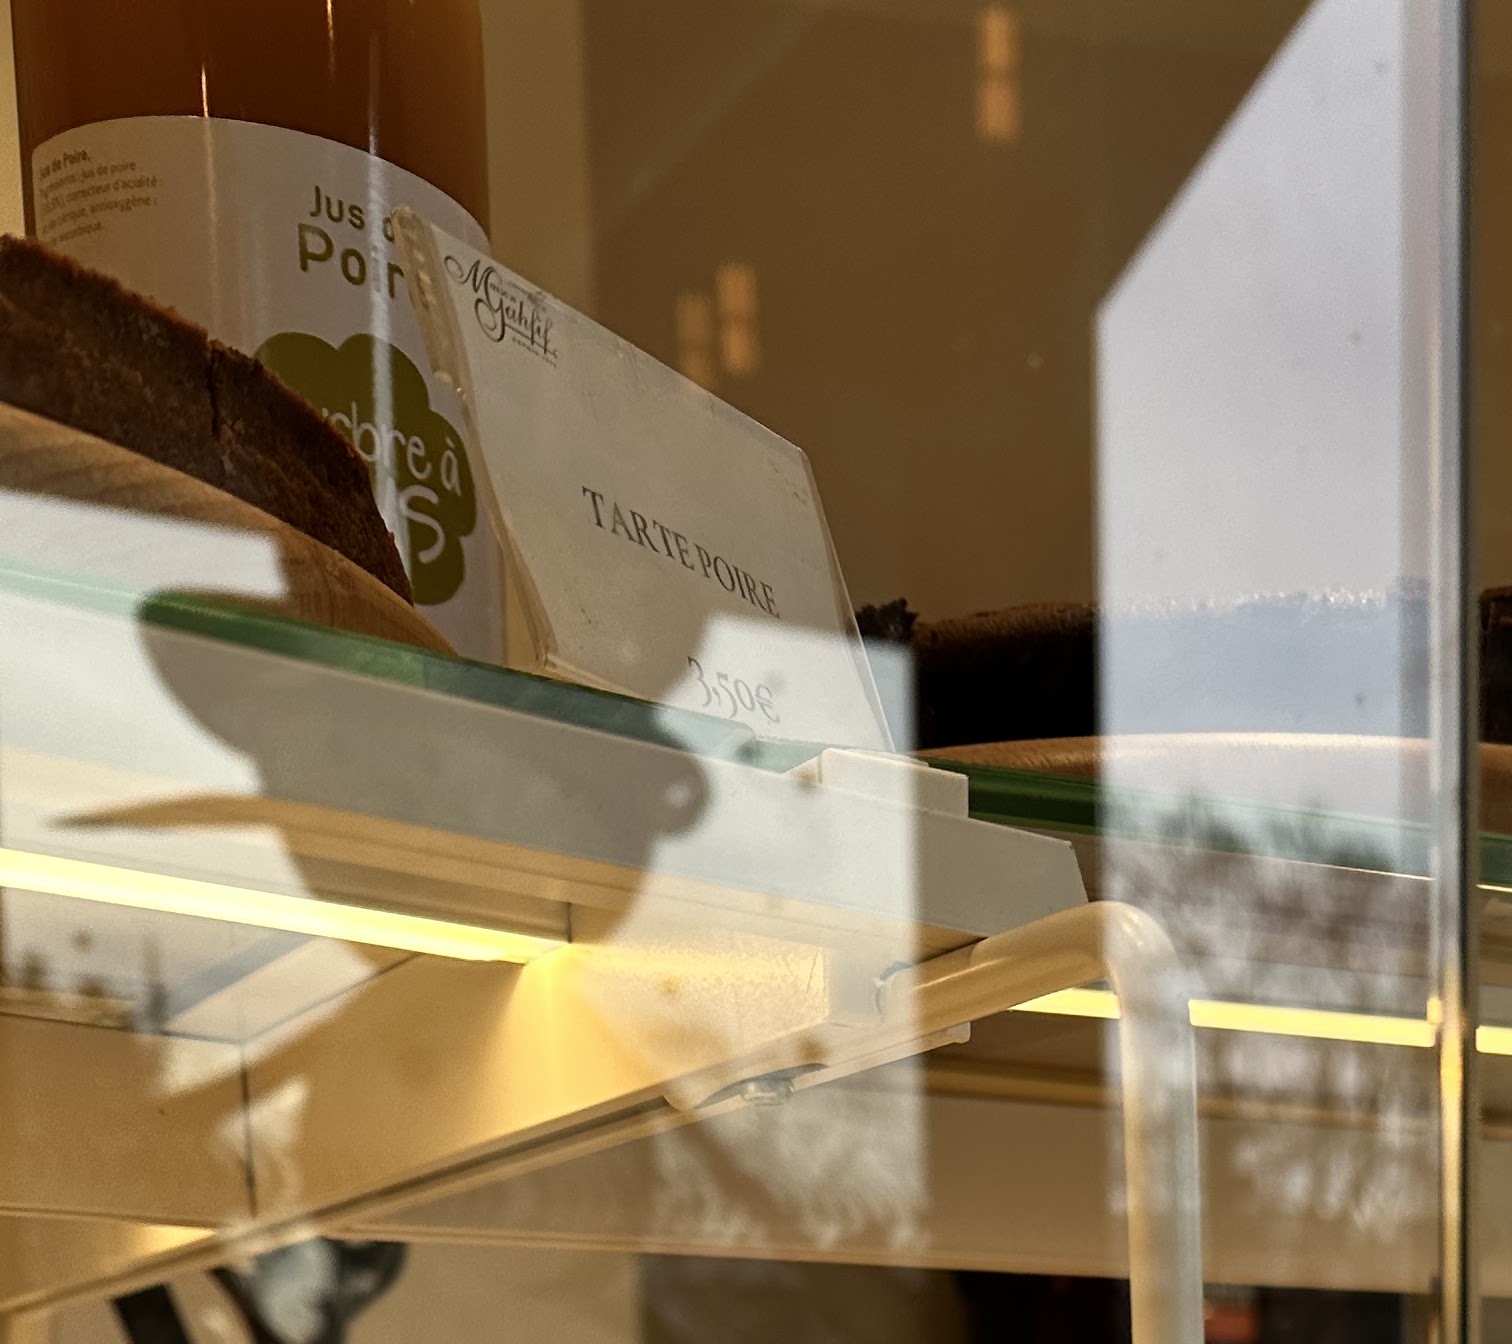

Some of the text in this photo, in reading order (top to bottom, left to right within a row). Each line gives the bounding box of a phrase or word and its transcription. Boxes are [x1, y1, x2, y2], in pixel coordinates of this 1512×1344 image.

[310, 185, 365, 230] Jus
[298, 223, 408, 300] Poir
[581, 485, 780, 619] TARTE POIRE
